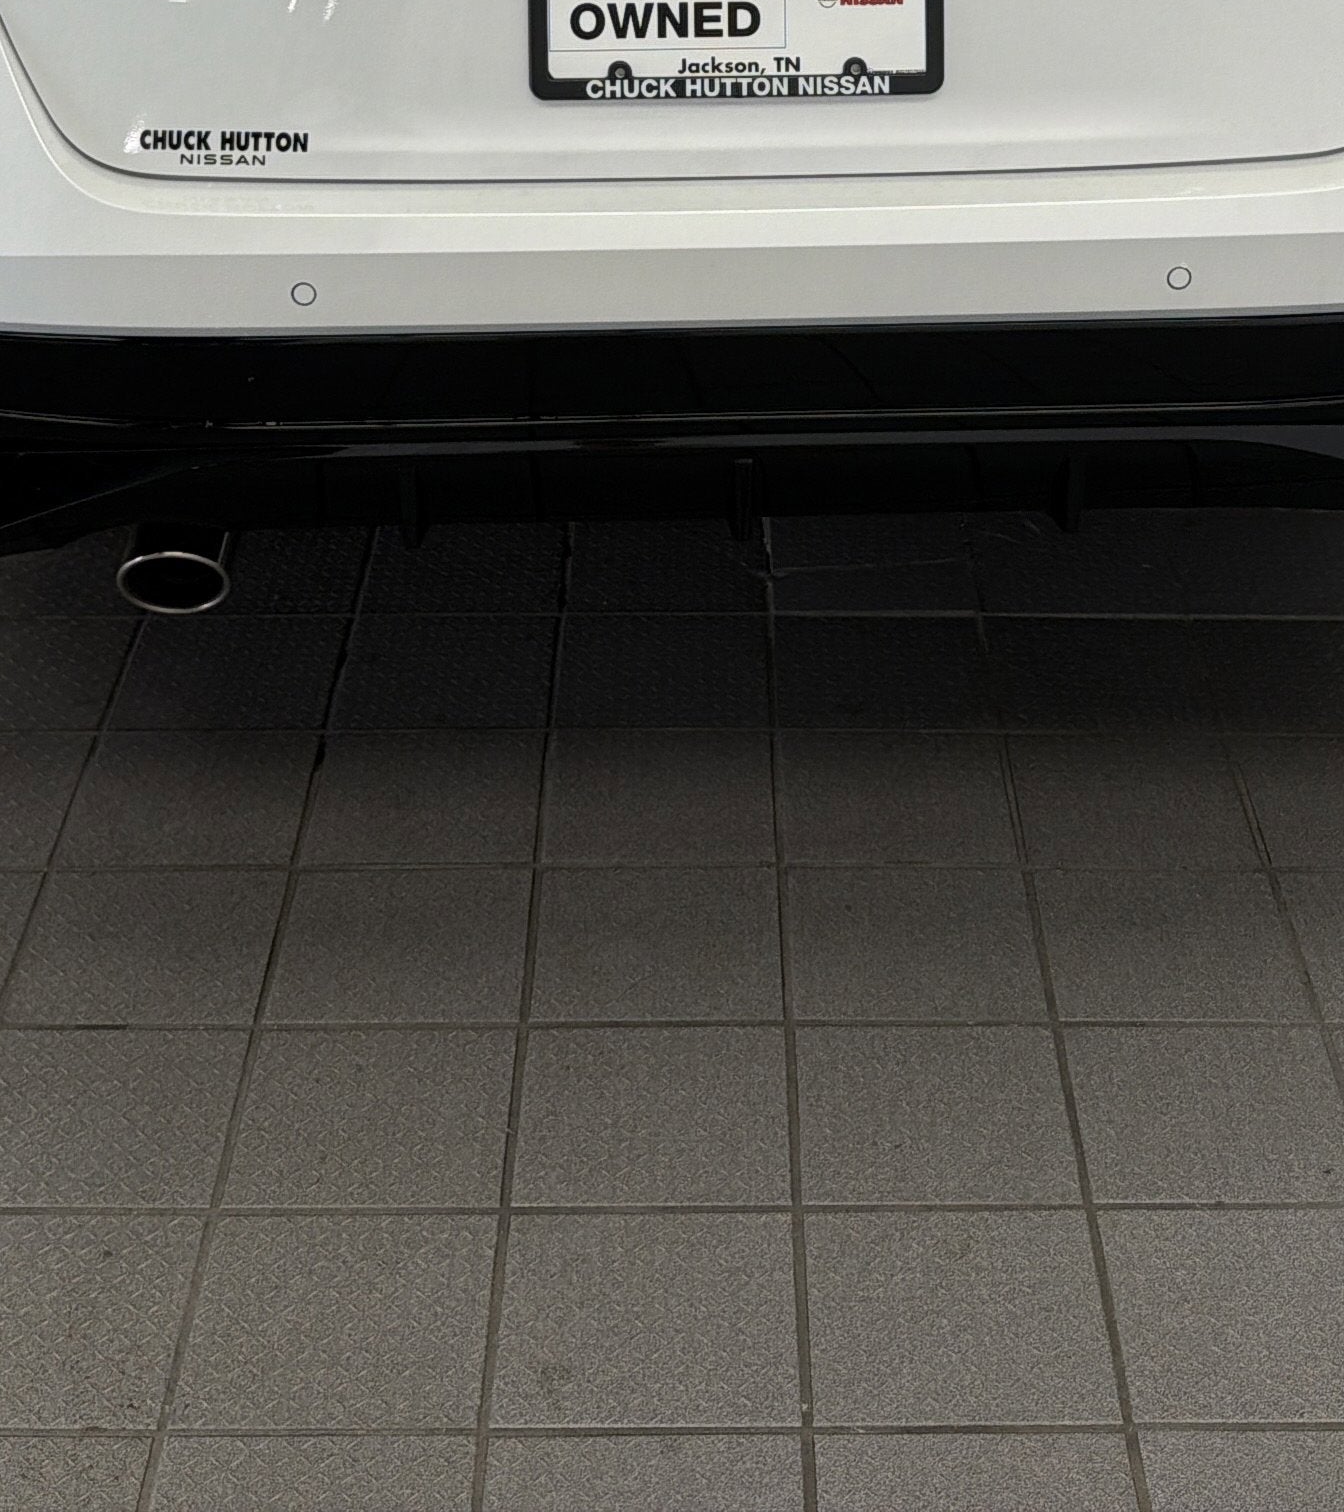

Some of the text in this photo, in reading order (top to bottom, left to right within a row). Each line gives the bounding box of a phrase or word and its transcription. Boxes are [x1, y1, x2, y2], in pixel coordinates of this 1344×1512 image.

[569, 1, 761, 40] OWNED
[677, 56, 801, 75] Jackson, TN
[585, 74, 891, 99] CHUCK HUTTON NISSAN
[139, 129, 309, 153] CHUCK HUTTON
[179, 153, 266, 166] NISSAN
